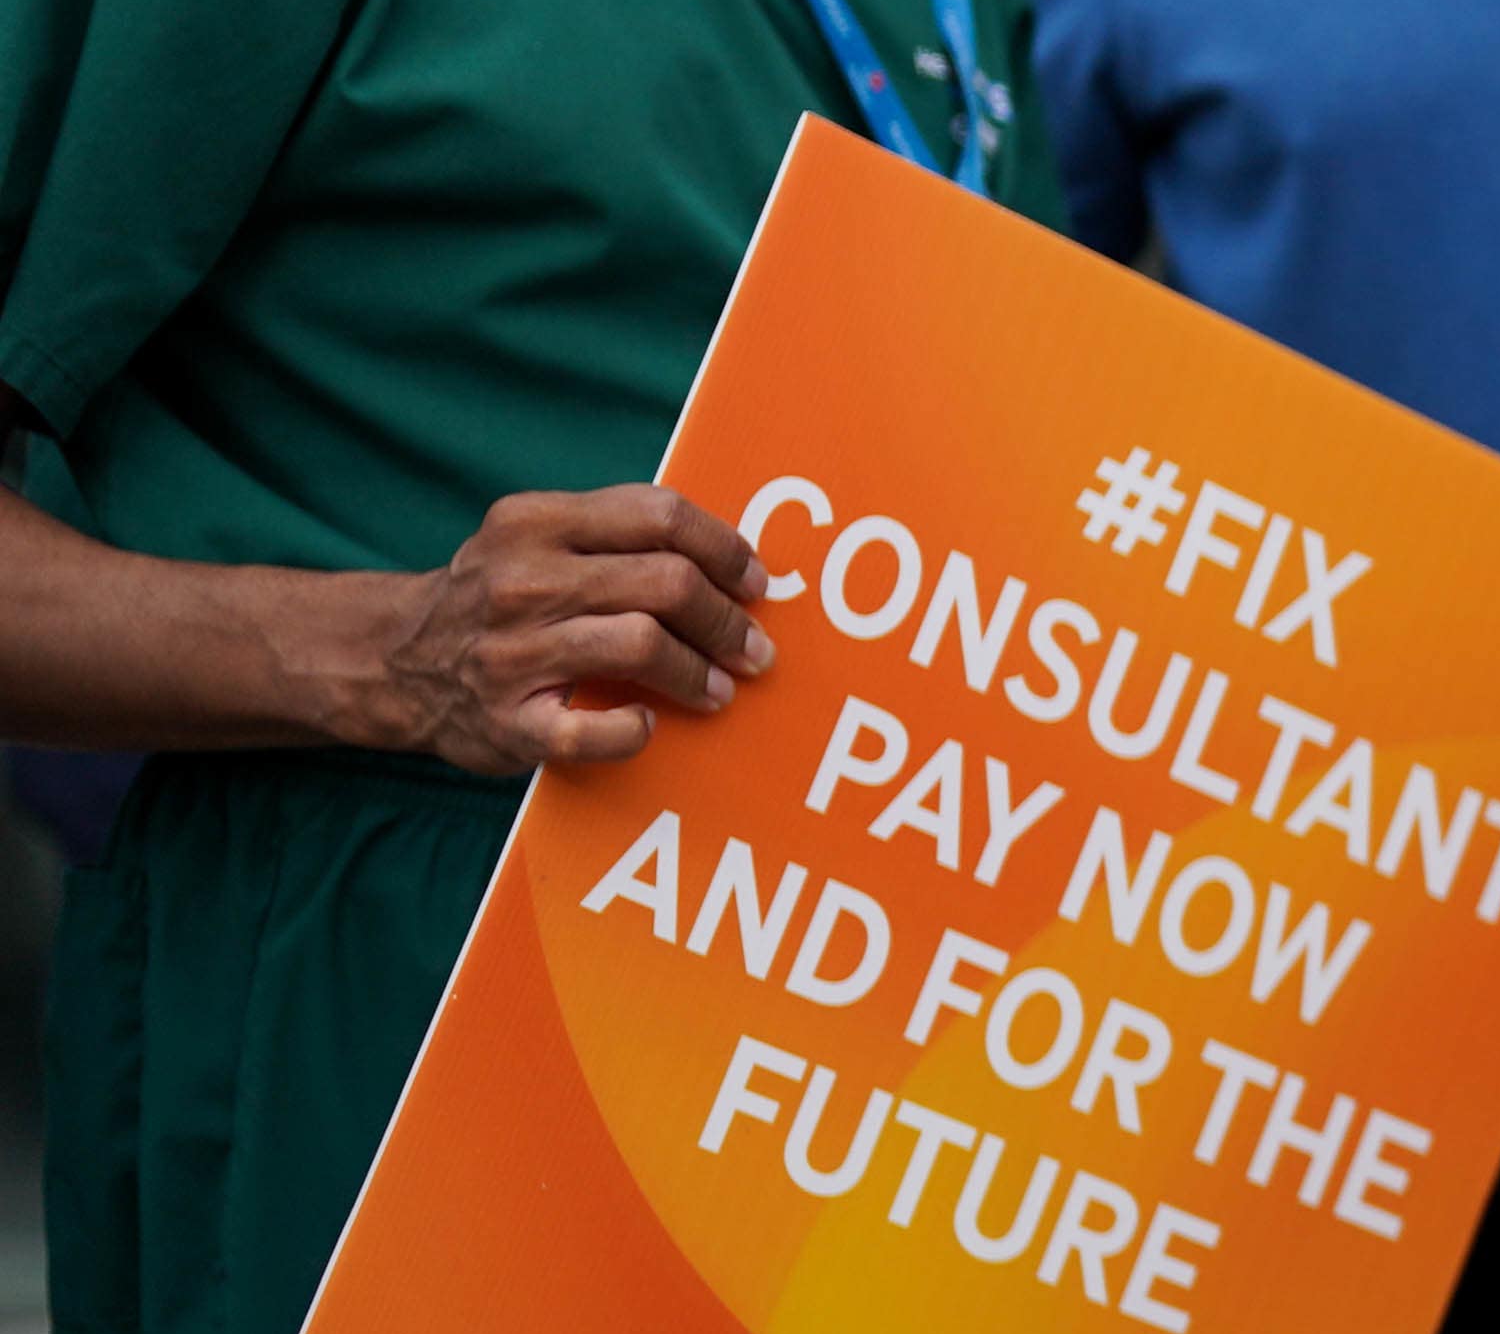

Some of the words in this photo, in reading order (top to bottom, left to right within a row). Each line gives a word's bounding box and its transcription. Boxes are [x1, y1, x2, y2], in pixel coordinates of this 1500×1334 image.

[1078, 449, 1370, 665] #FIX
[806, 696, 1064, 885] PAY
[1060, 809, 1371, 1023] NOW
[581, 811, 891, 1005] AND
[906, 931, 1170, 1133] FOR
[1196, 1041, 1431, 1238] THE
[700, 1036, 1220, 1334] FUTURE
